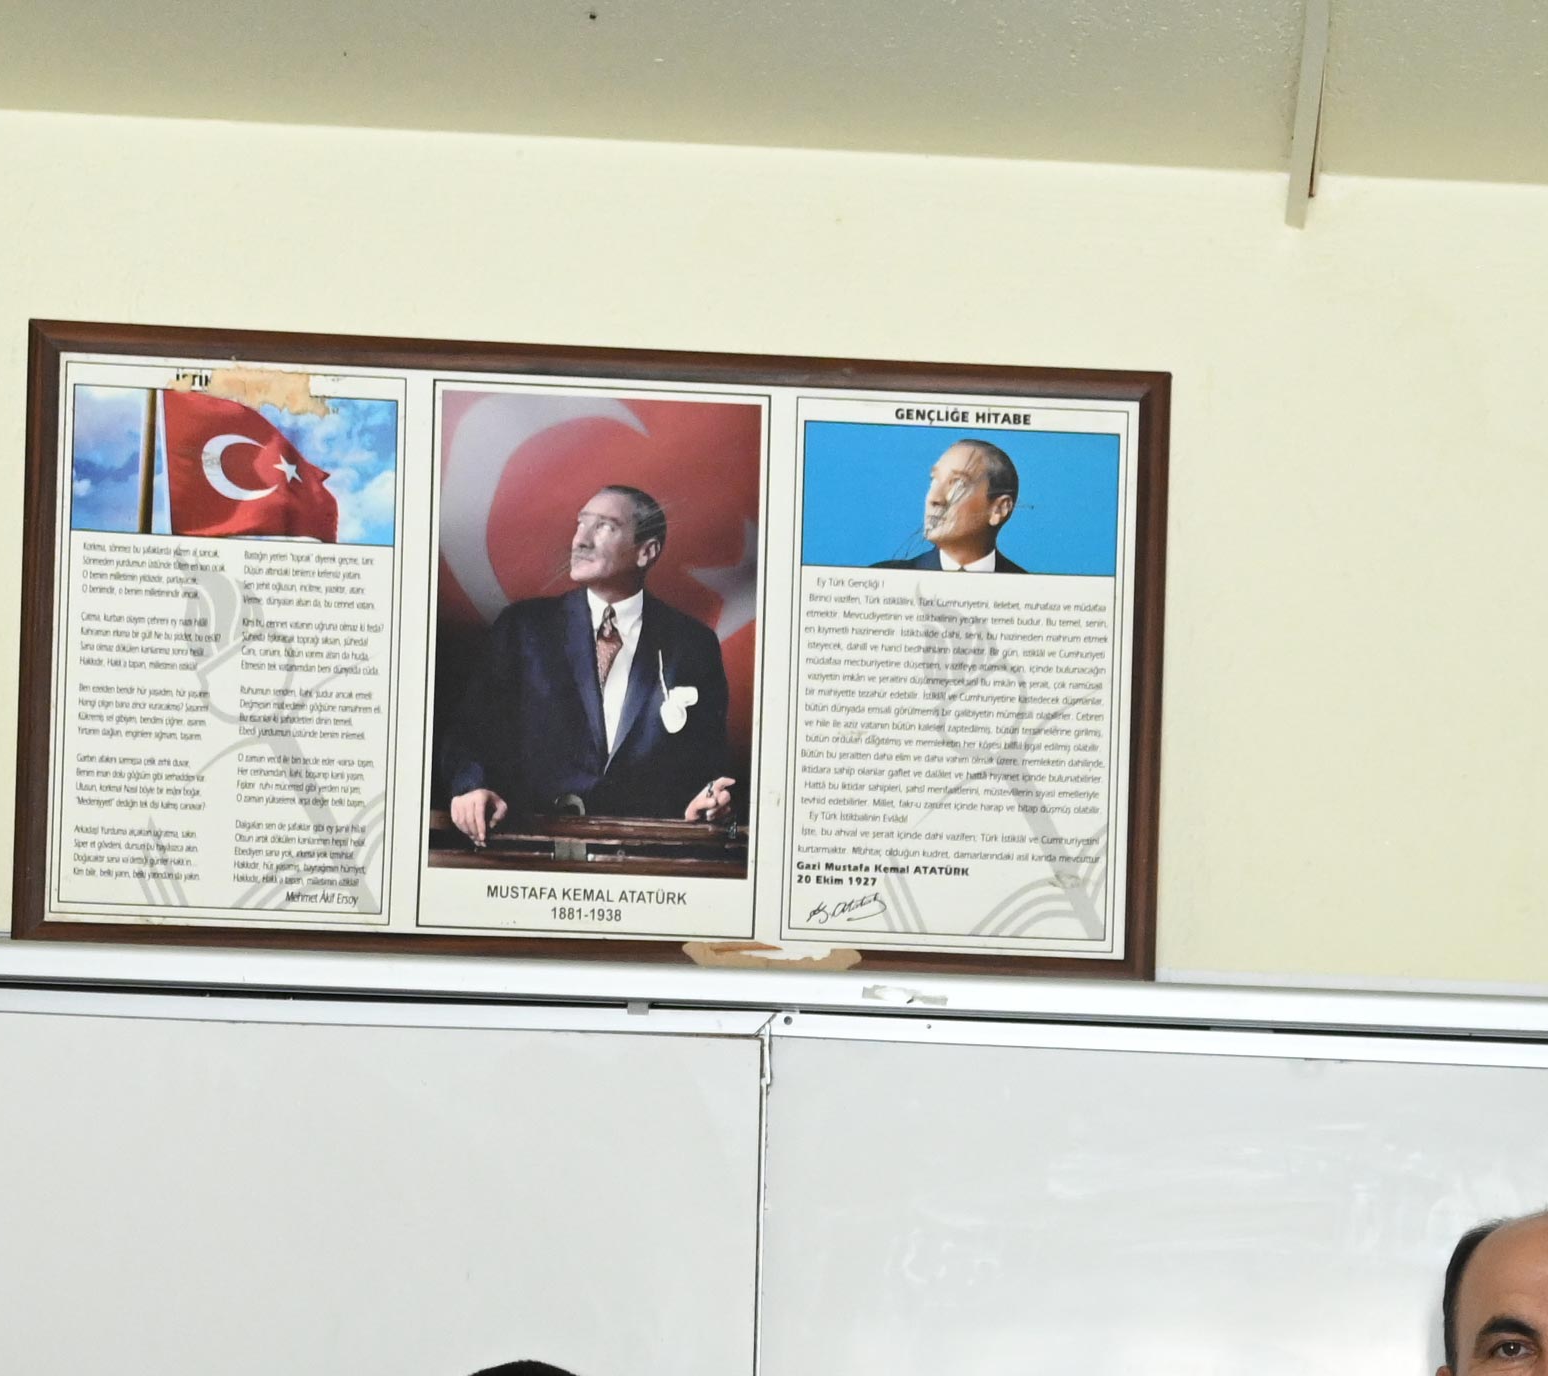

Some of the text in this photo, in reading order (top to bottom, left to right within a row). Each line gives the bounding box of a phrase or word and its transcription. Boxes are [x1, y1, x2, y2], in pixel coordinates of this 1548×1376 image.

[895, 407, 1031, 426] GENÇLİĞE HİTABE
[829, 576, 845, 587] Türk
[797, 861, 969, 876] Gazi Mustafa Kemal ATATÜRK
[797, 874, 877, 886] 20 Ekim 1927
[487, 885, 687, 905] MUSTAFA KEMAL ATATÜRK
[551, 907, 622, 922] 1881-1938
